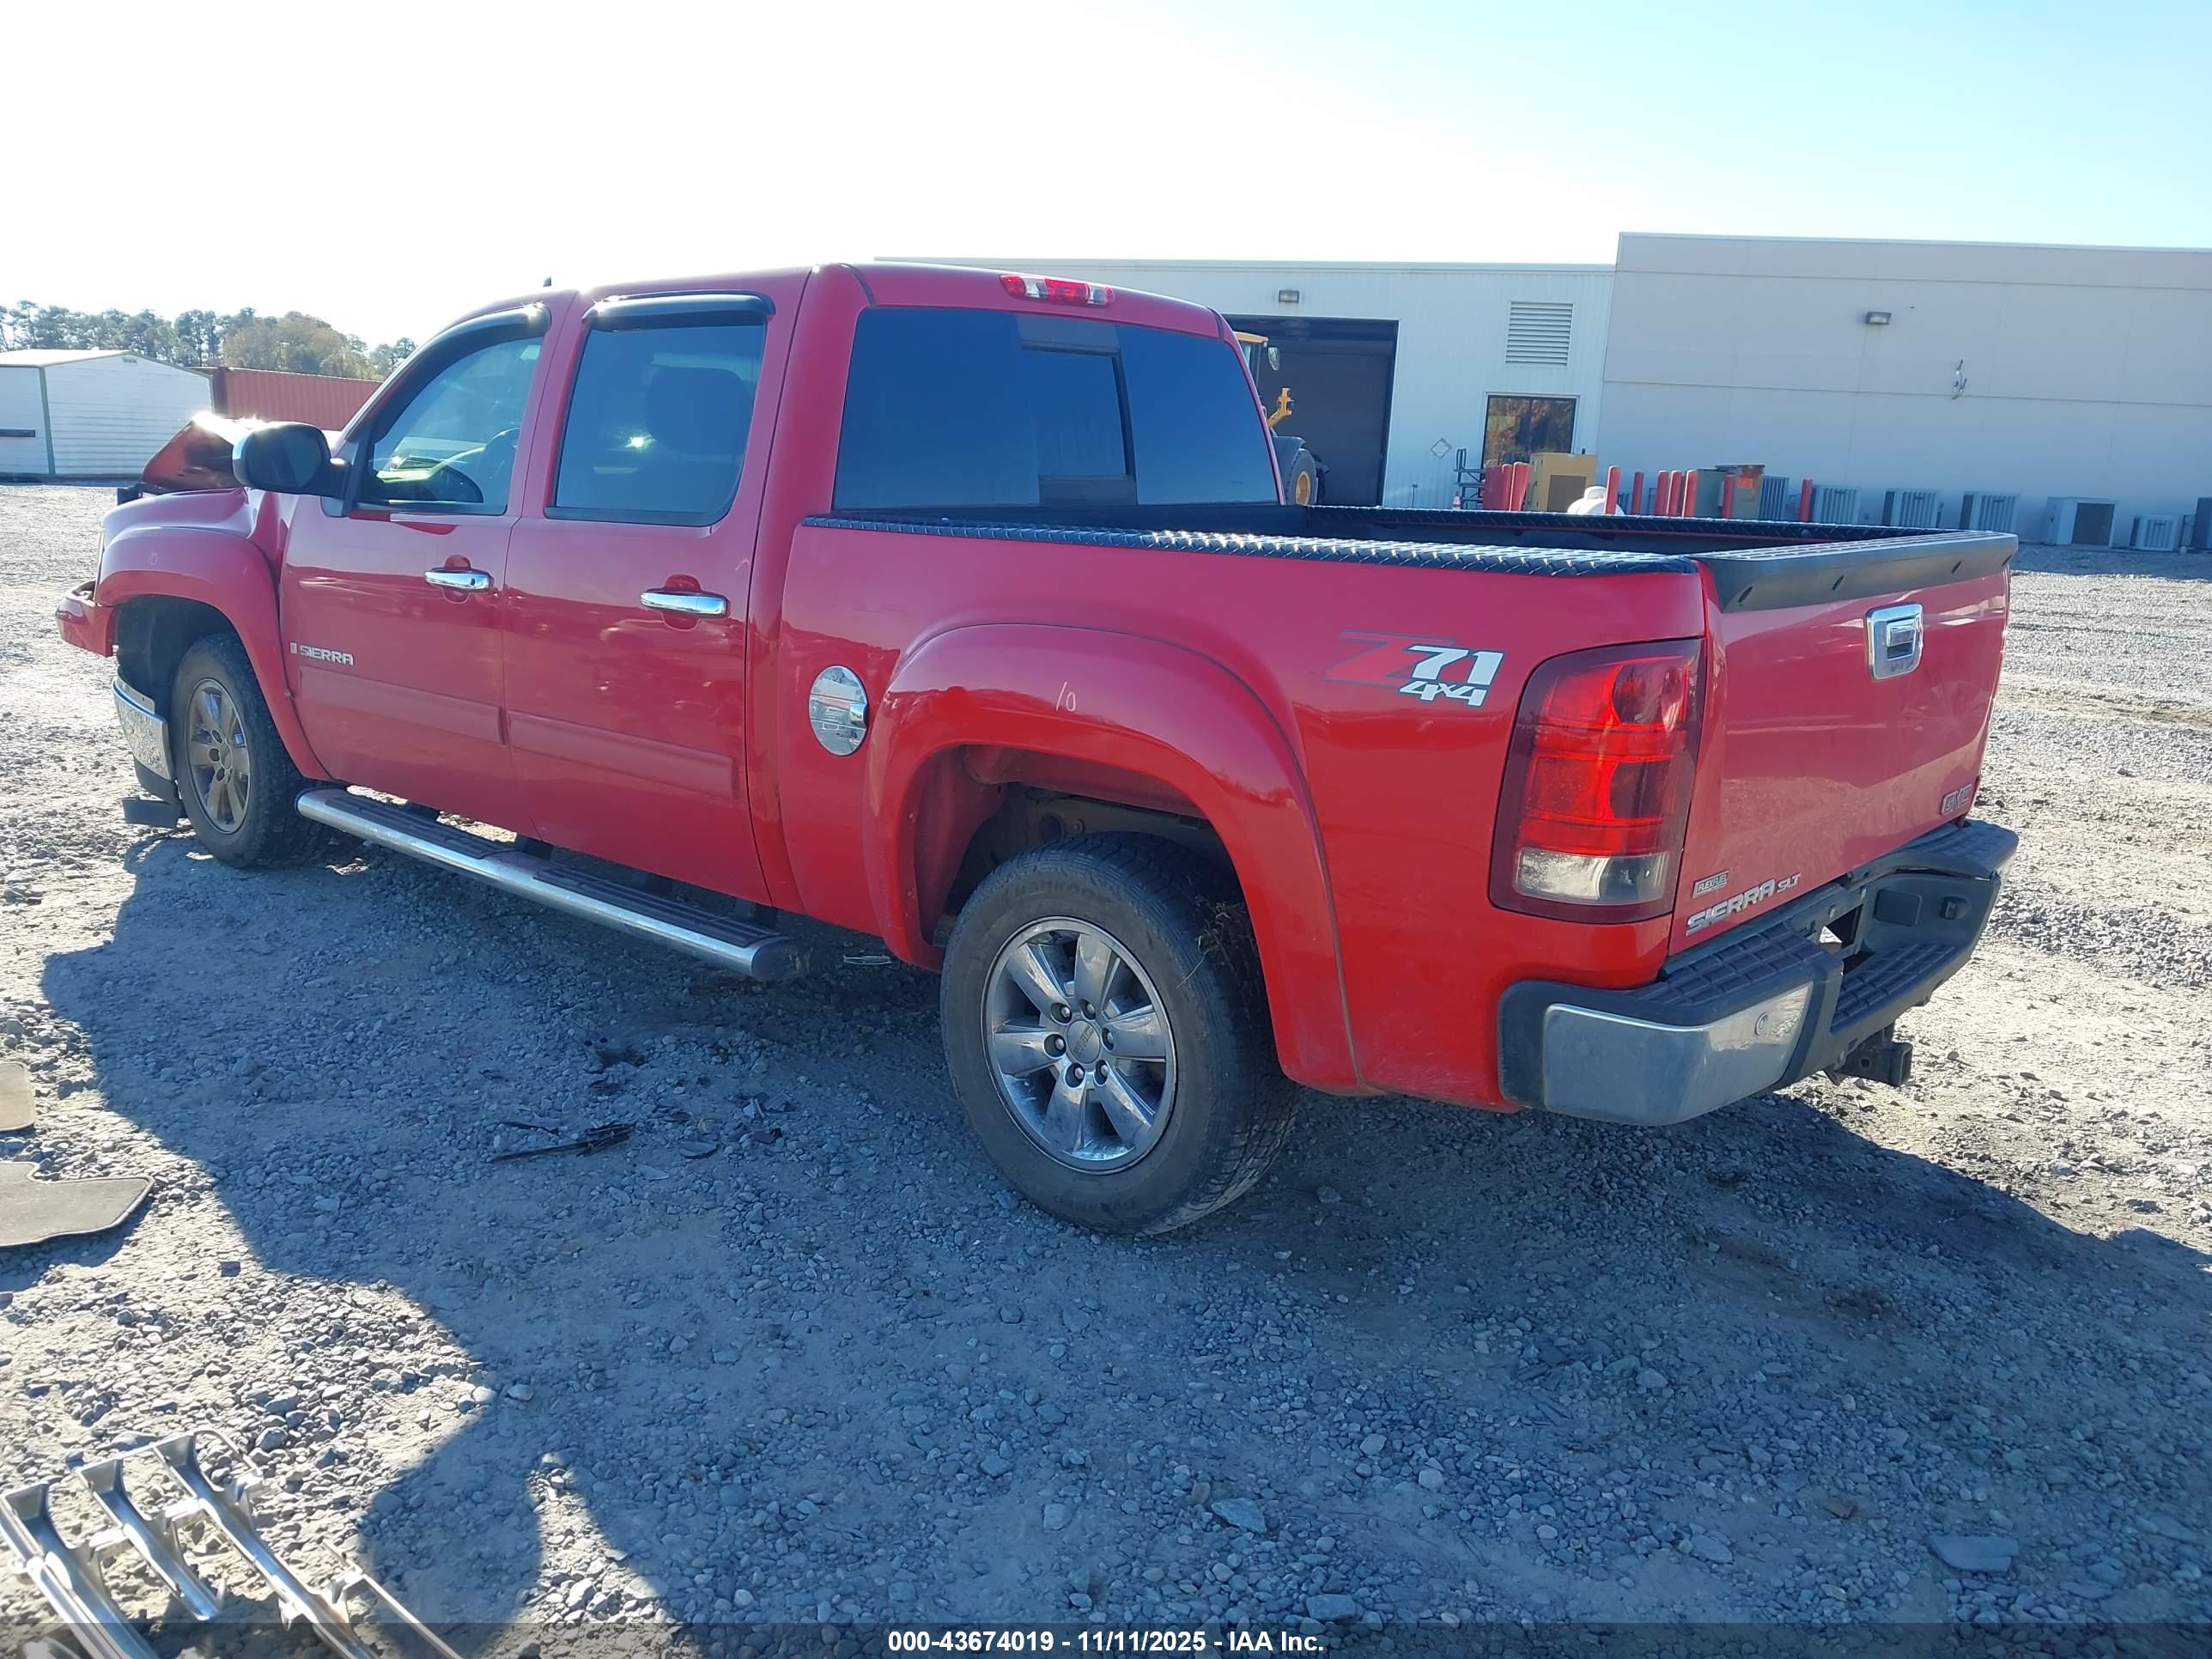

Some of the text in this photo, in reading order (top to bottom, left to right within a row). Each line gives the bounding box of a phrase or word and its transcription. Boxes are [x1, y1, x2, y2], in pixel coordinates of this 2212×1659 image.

[299, 644, 354, 666] SIERRA
[1322, 629, 1506, 687] Z71
[1055, 681, 1077, 713] 10
[1941, 784, 1973, 815] GMC
[1686, 872, 1802, 937] SIERRA SLT
